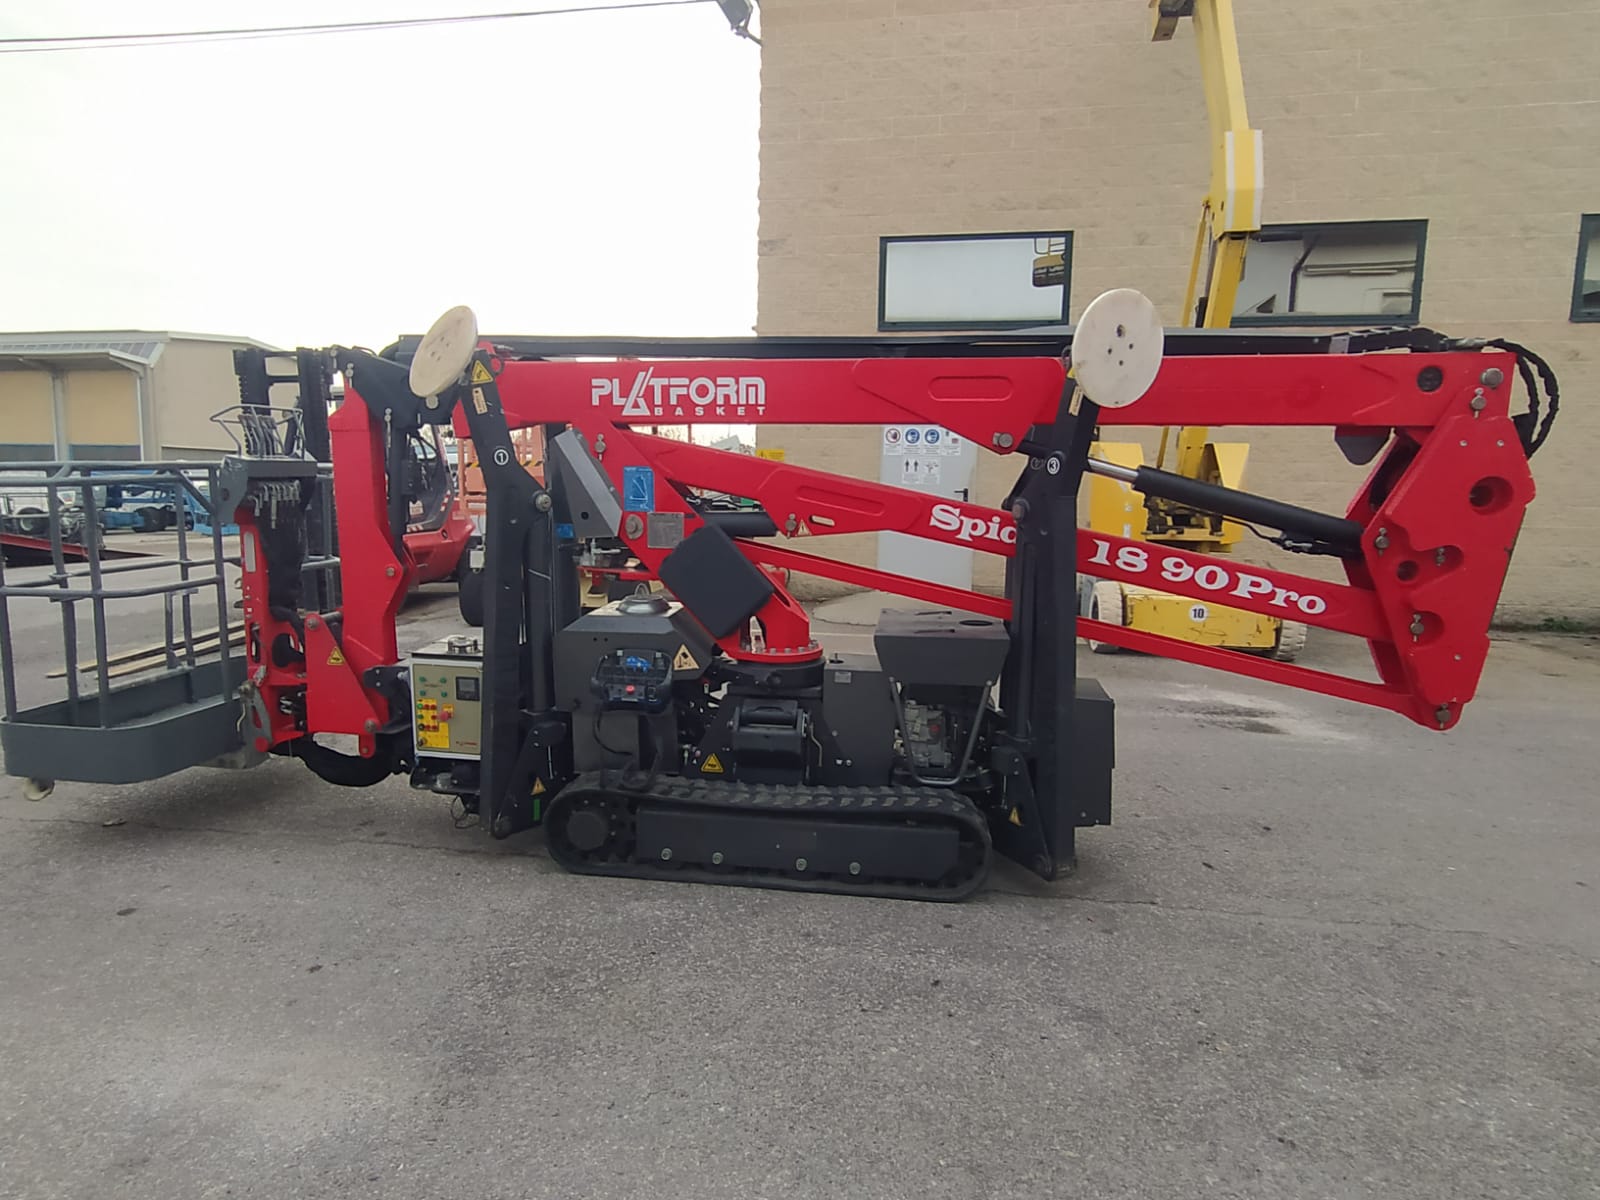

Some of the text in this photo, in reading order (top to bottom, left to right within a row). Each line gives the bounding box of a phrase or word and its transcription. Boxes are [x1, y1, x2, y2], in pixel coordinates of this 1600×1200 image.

[591, 366, 766, 416] PLATFORM
[654, 406, 766, 416] BASKET
[1087, 539, 1149, 573] 18
[1192, 608, 1205, 619] 10
